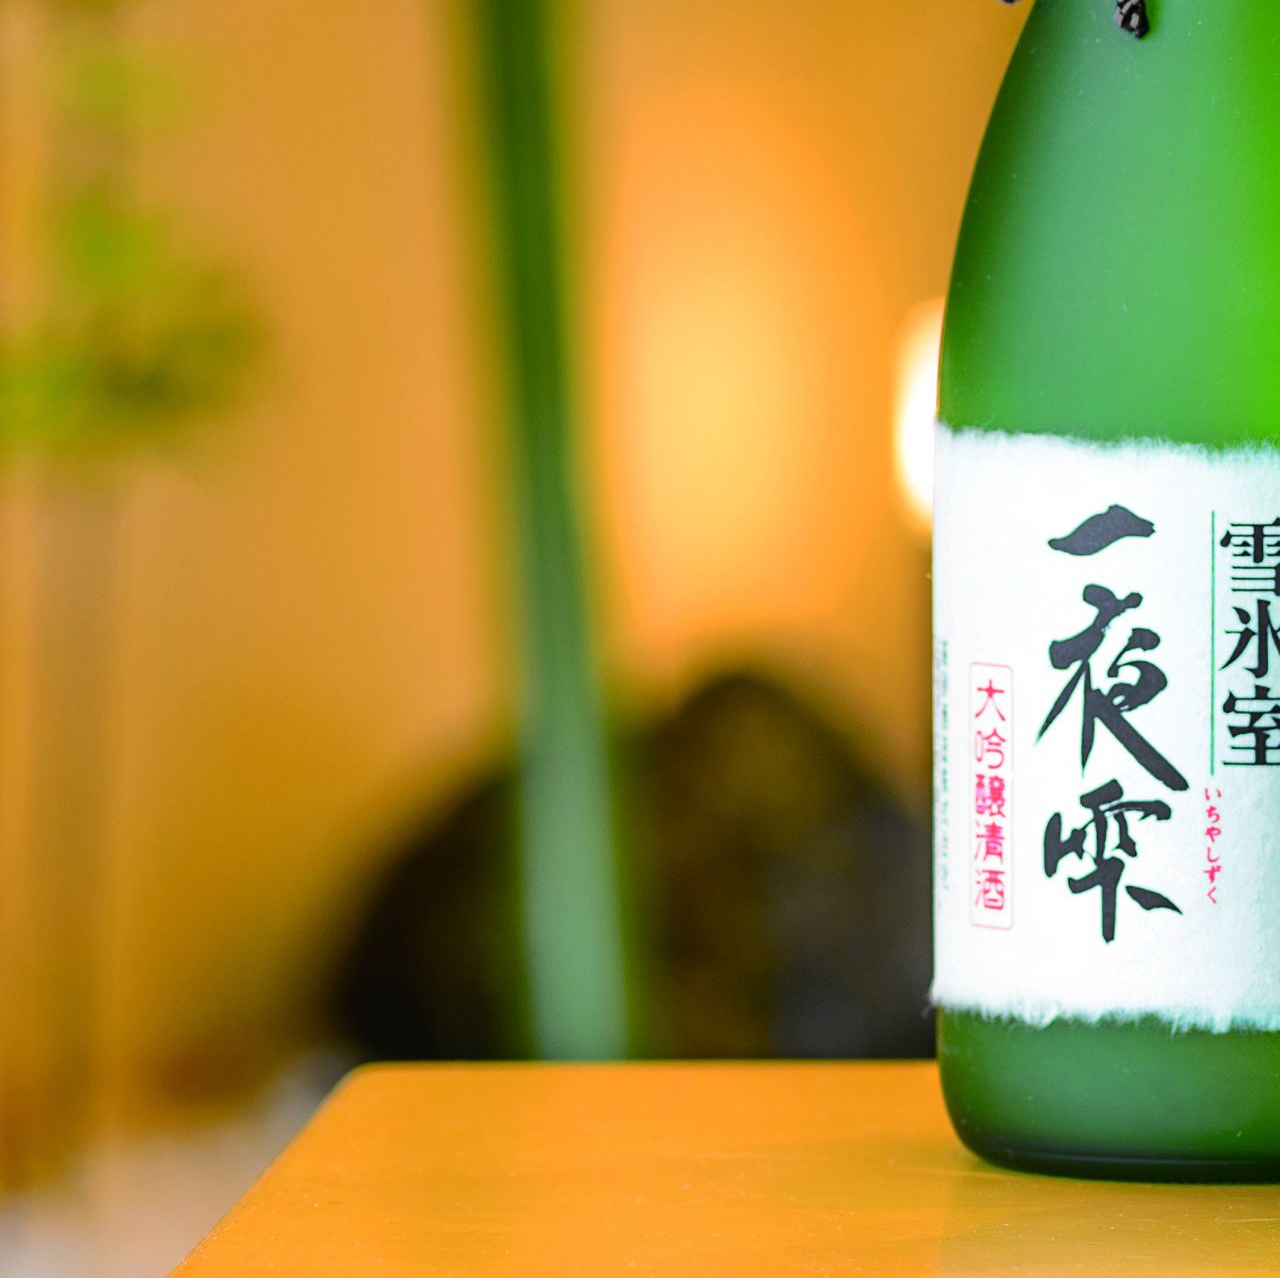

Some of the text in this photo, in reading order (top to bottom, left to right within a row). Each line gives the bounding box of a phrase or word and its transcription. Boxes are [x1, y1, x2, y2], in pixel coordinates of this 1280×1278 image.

[1034, 504, 1190, 944] 一夜雫
[1203, 787, 1222, 904] いちやしずく
